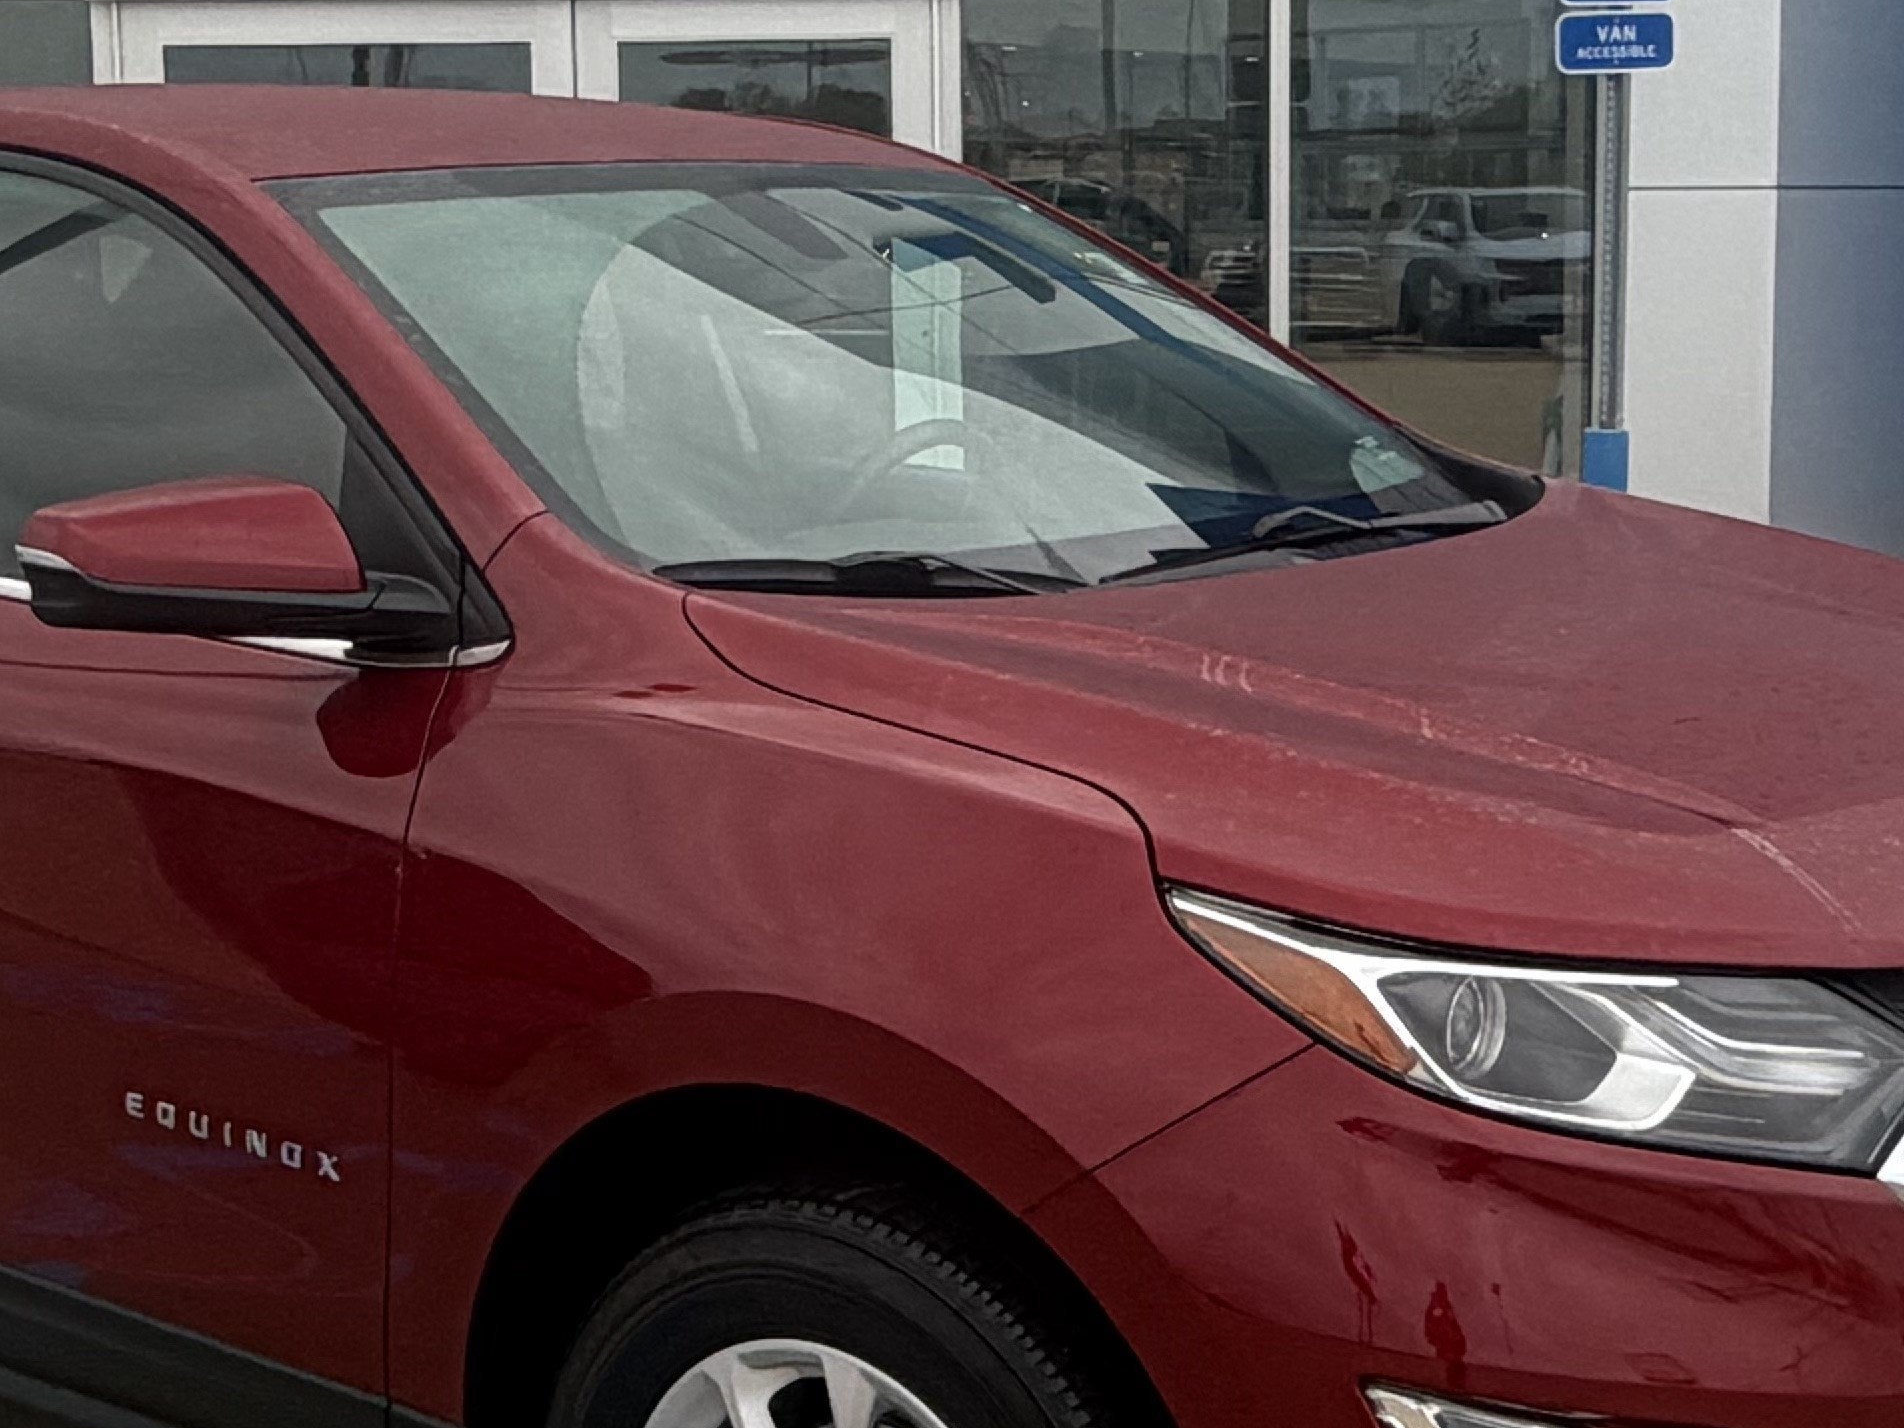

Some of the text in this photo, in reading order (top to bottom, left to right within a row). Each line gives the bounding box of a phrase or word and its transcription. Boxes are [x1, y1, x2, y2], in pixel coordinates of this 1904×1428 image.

[1596, 25, 1637, 42] VAN
[1576, 43, 1658, 60] ACCESSIBLE
[125, 1090, 341, 1183] EQUINOX
